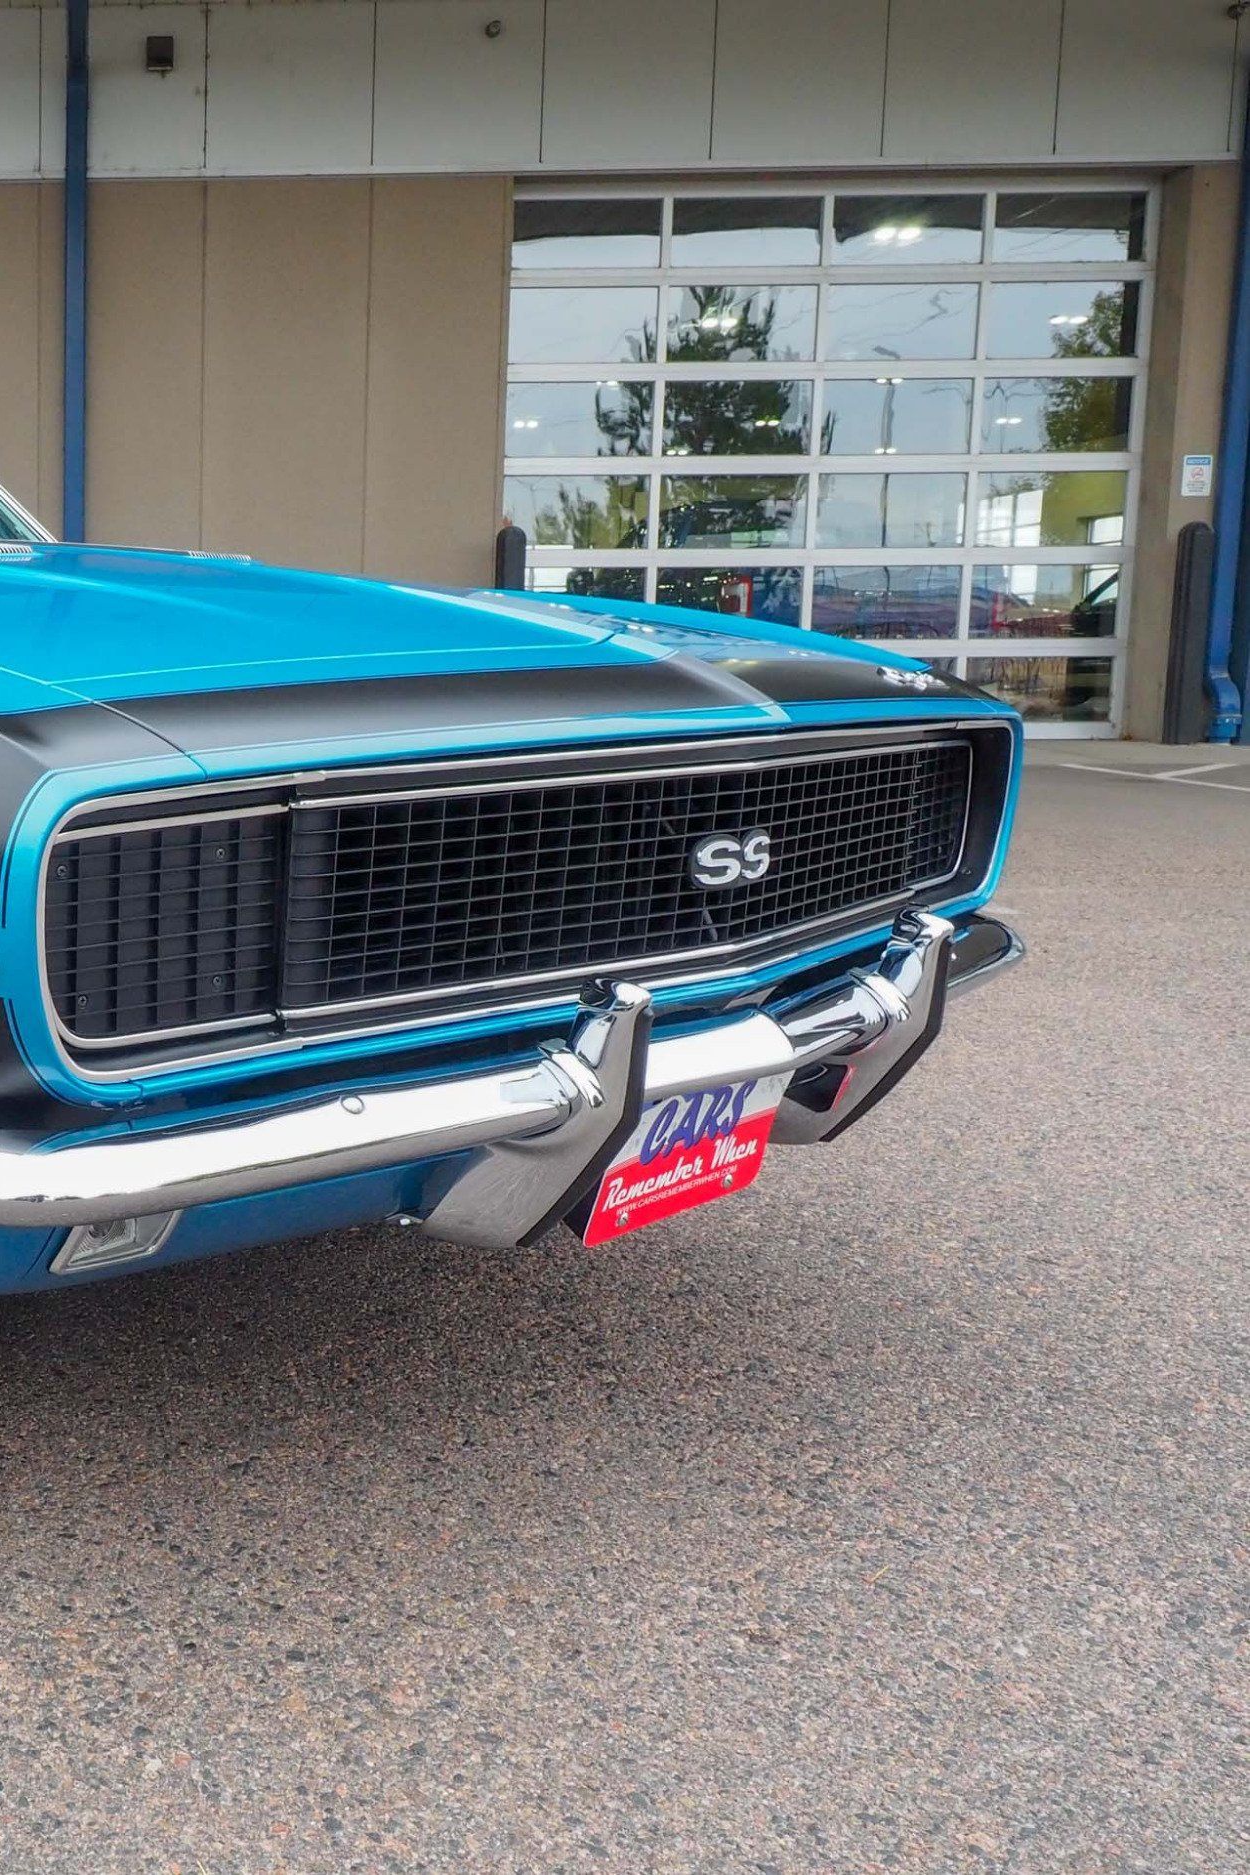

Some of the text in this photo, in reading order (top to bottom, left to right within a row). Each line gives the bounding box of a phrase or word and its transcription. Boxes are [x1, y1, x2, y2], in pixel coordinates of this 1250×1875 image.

[695, 835, 772, 885] SS
[639, 1078, 758, 1166] CARS
[602, 1133, 758, 1213] Remember When
